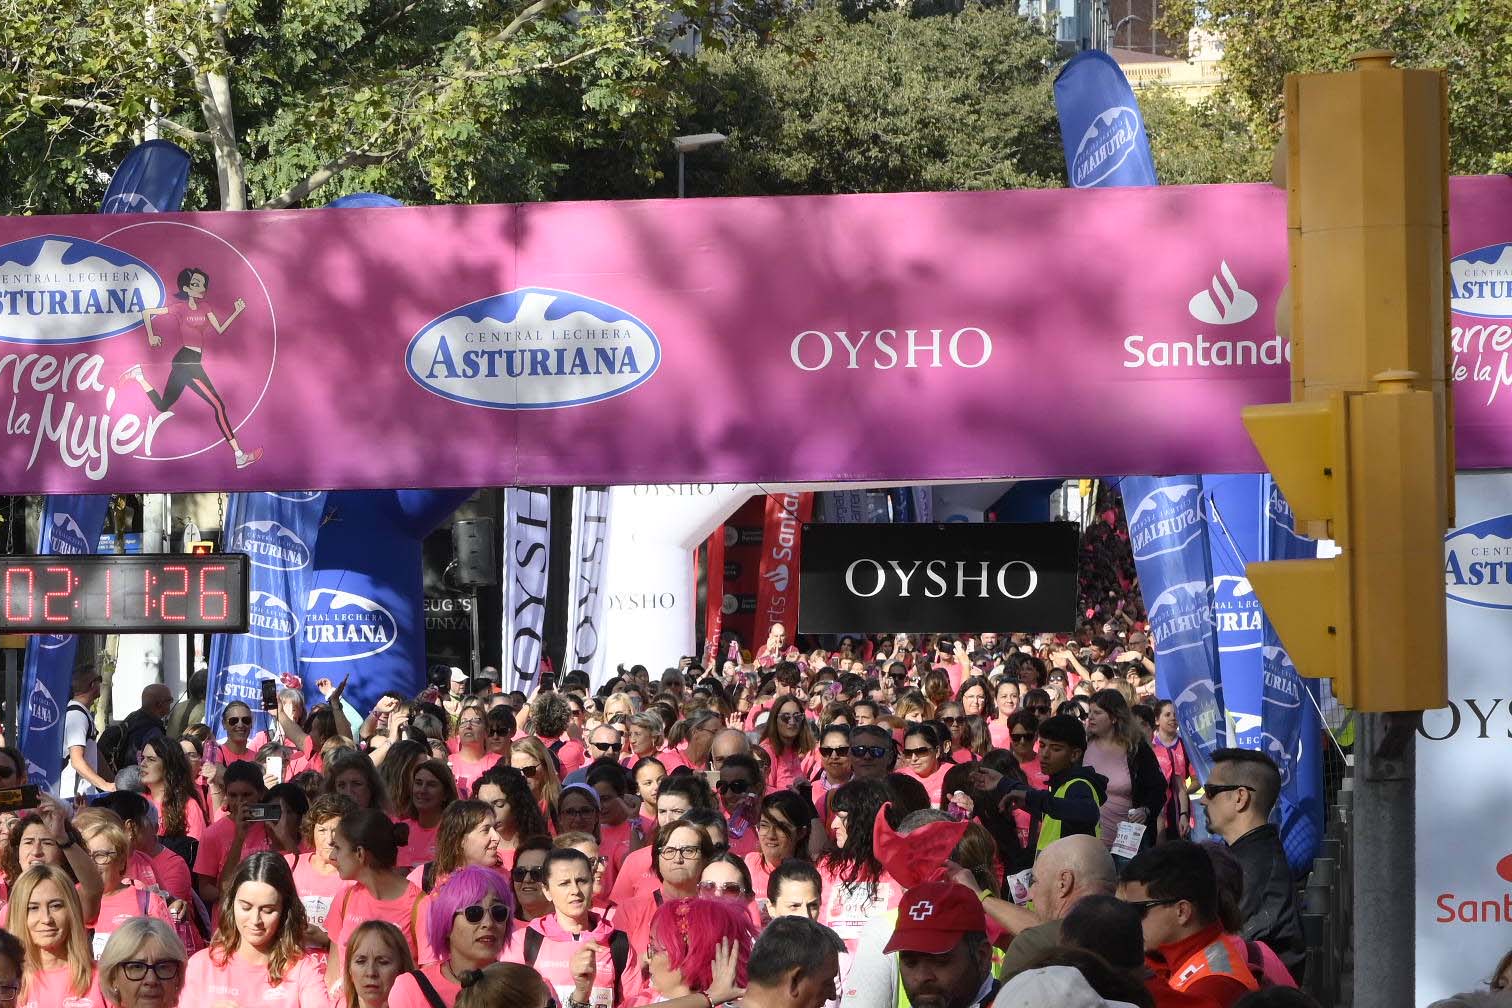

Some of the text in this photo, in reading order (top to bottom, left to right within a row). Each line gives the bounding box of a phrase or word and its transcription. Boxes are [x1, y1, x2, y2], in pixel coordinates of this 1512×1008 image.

[67, 270, 141, 283] LECHERA
[464, 327, 633, 343] CENTRAL LECHERA
[789, 326, 994, 371] OYSHO
[1451, 324, 1512, 353] arre
[425, 334, 641, 380] ASTURIANA
[1472, 352, 1492, 382] la
[6, 395, 31, 436] la
[25, 389, 175, 481] Mujer
[4, 565, 228, 621] 02:11:26
[844, 557, 1039, 600] OYSHO
[302, 624, 389, 644] URIANA
